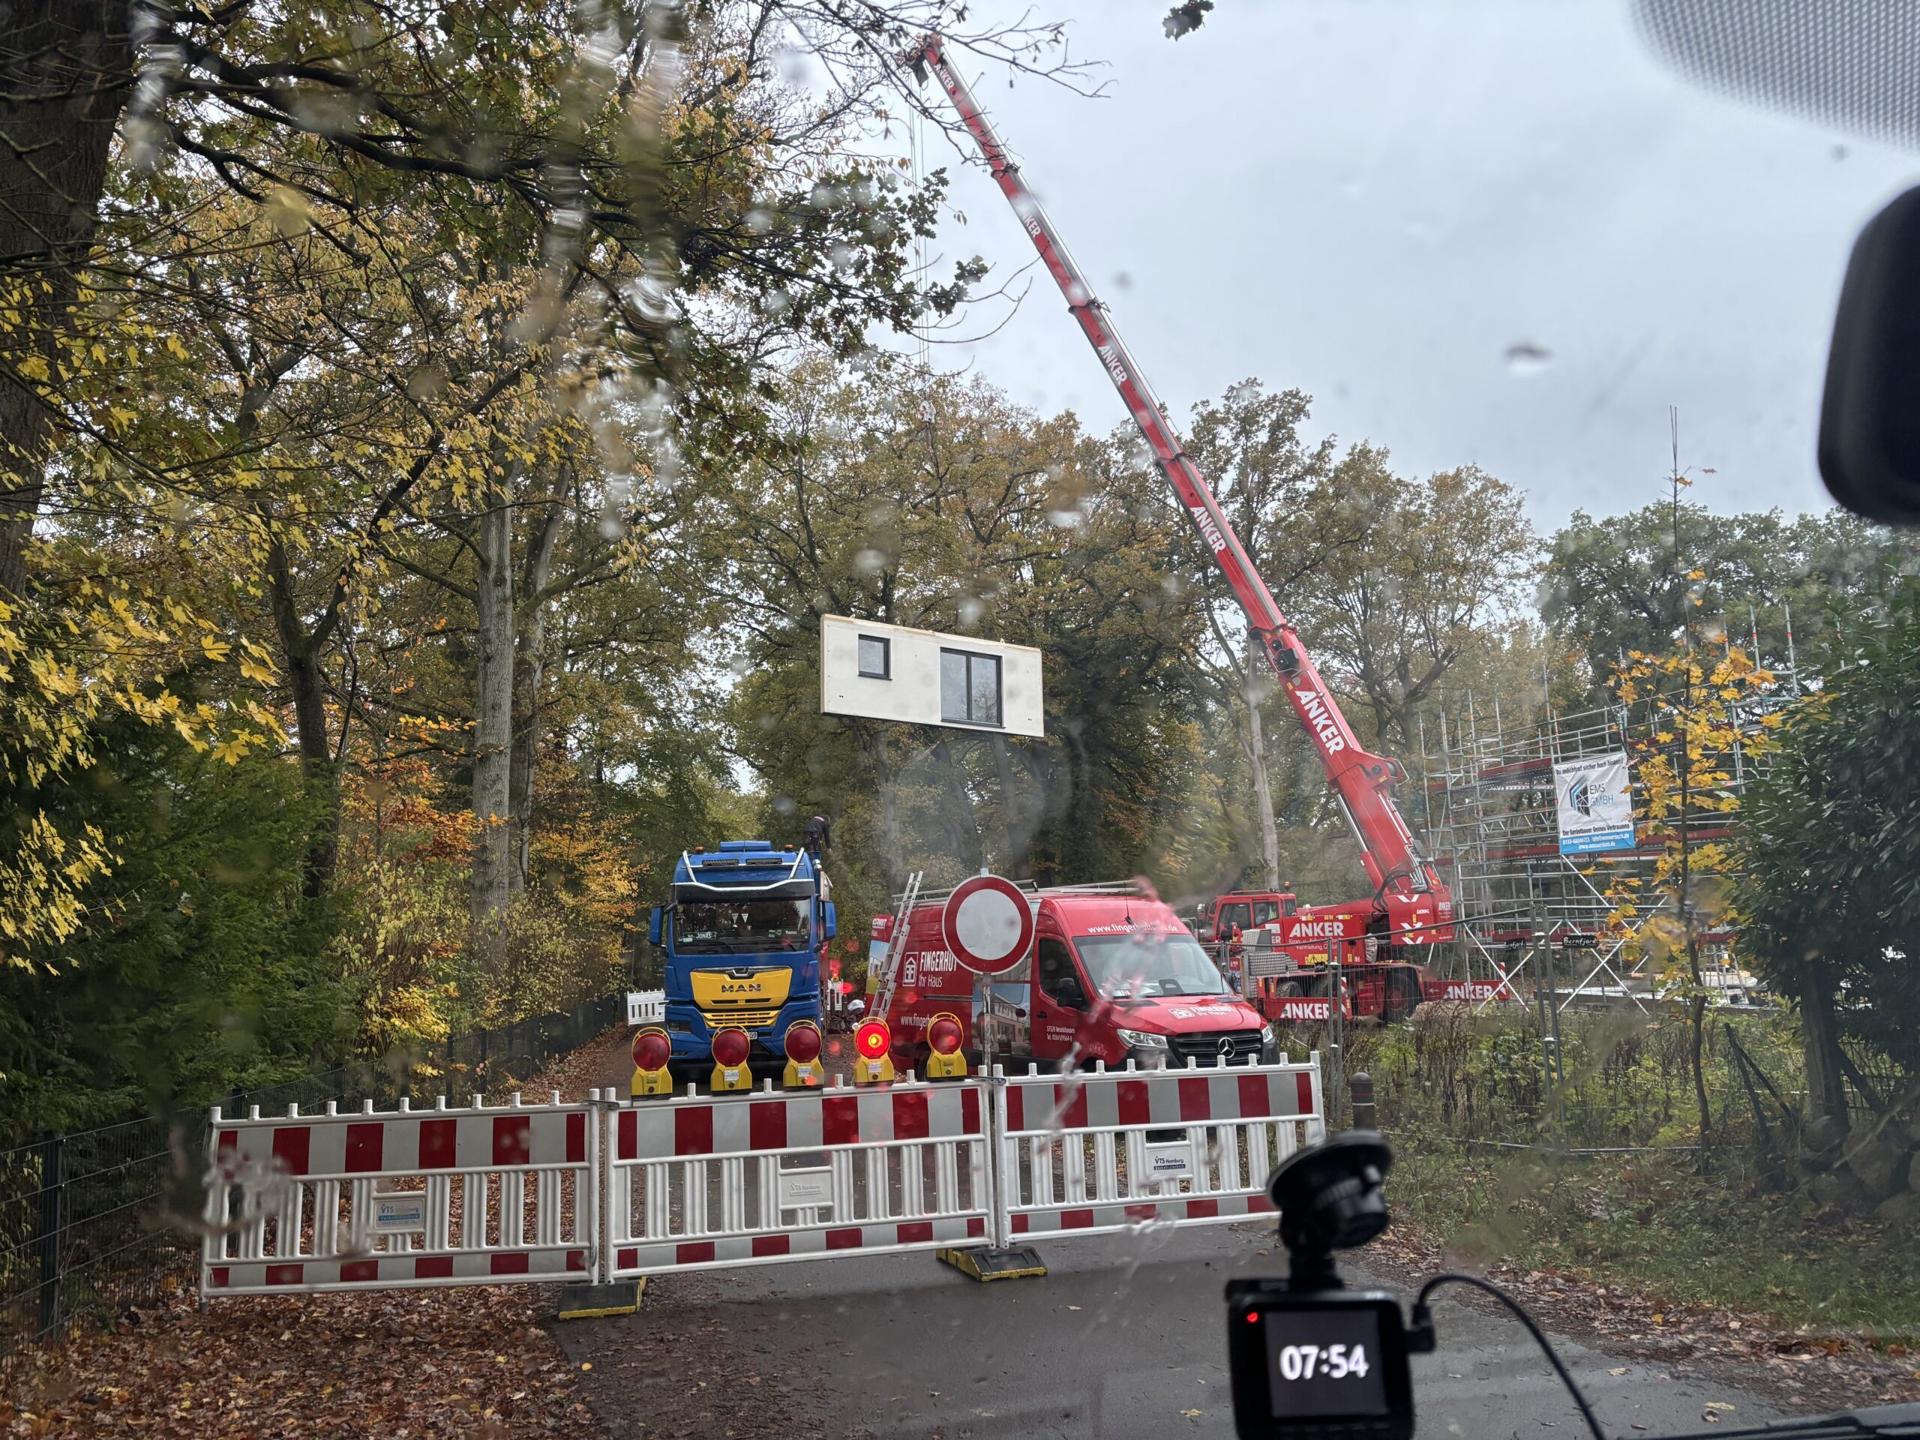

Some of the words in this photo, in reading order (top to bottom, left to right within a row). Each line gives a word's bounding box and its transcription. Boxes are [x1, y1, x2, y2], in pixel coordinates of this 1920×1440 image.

[1098, 345, 1127, 385] ANKER
[1190, 506, 1226, 555] ANKER
[1295, 690, 1345, 756] ANKER
[1589, 783, 1606, 795] EMS
[1590, 794, 1614, 807] GMBH
[1289, 922, 1344, 938] ANKER
[919, 951, 957, 972] FINGERHUT
[721, 984, 762, 993] MAN
[928, 975, 943, 988] Haus
[1443, 983, 1493, 1000] ANKER
[1280, 1003, 1331, 1020] ANKER
[1279, 1344, 1370, 1381] 07:54
